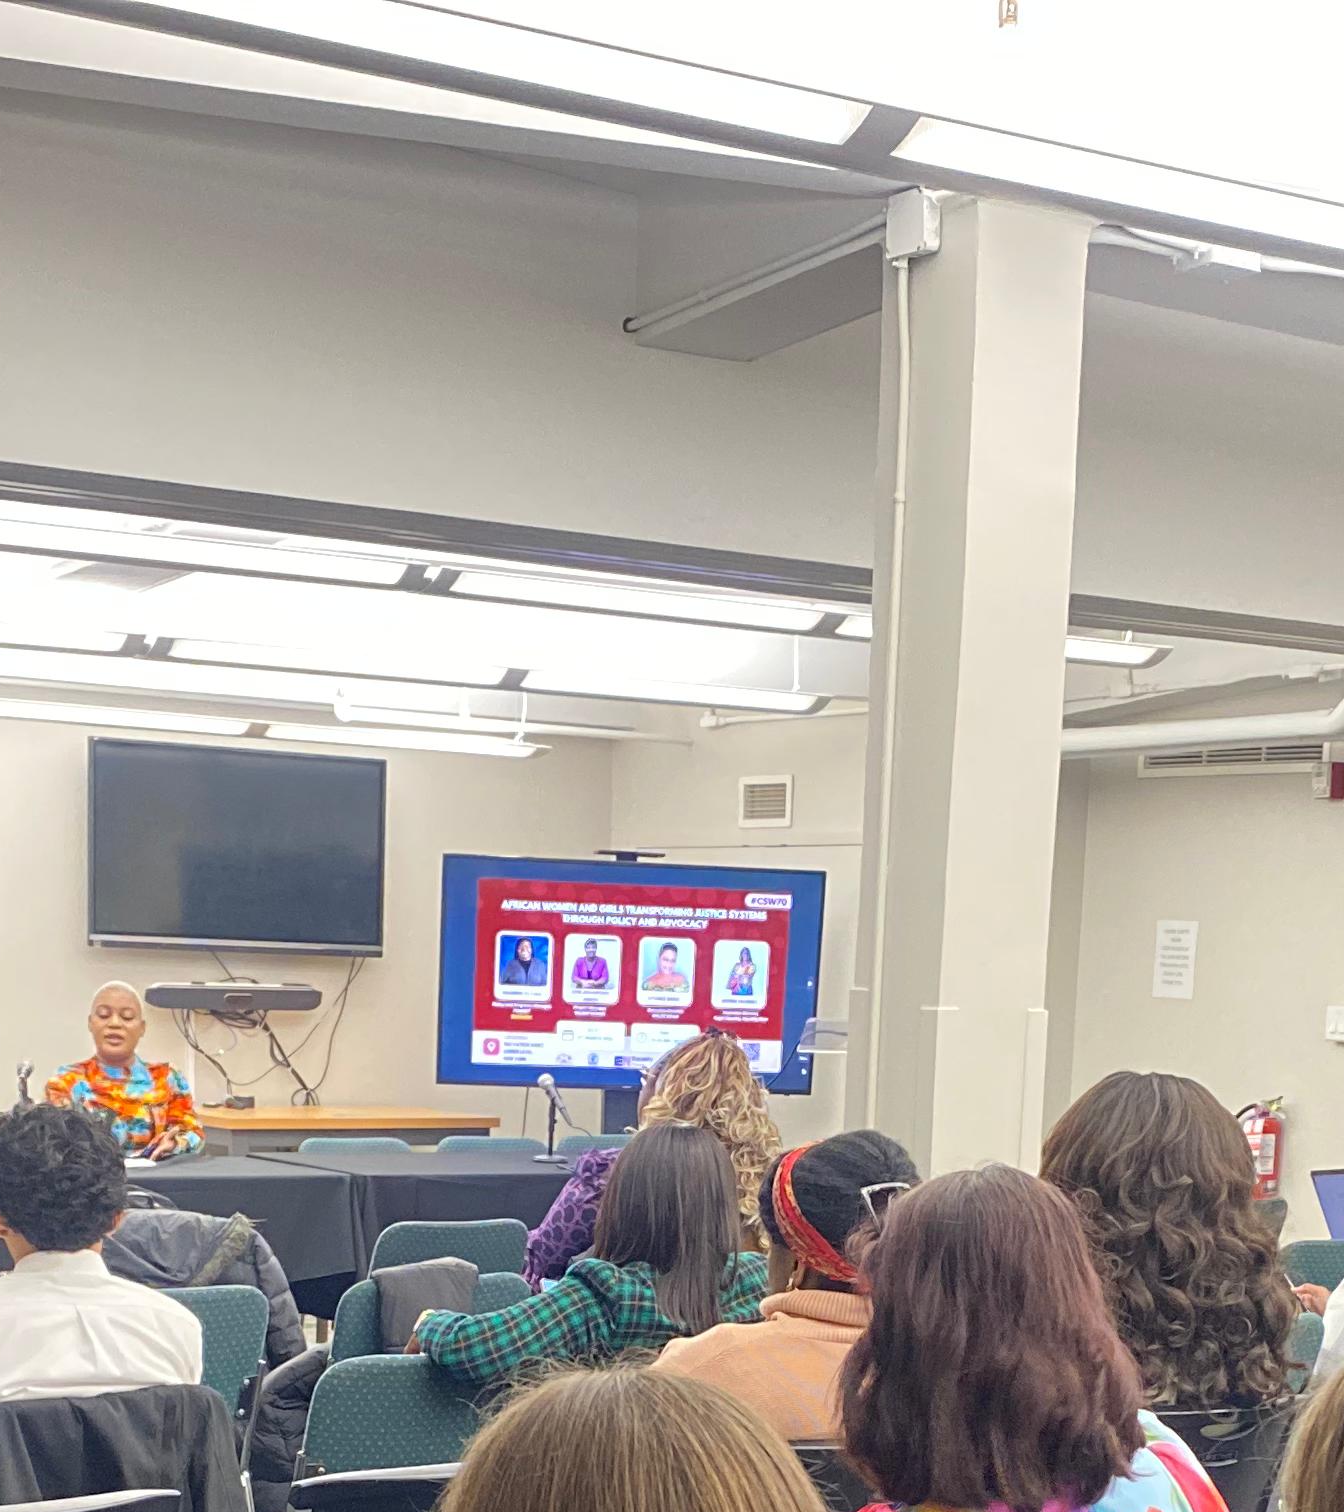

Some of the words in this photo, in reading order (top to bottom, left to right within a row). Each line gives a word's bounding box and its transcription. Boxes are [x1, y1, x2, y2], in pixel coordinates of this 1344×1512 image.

[751, 895, 788, 906] #CSW70
[501, 899, 541, 910] AFRICAN
[542, 901, 577, 912] WOMEN
[578, 903, 597, 913] AND
[694, 908, 728, 919] JUSTICE
[729, 910, 767, 921] SYSTEMS
[562, 914, 604, 924] THROUGH
[606, 915, 637, 926] POLICY
[638, 917, 657, 927] AND
[658, 918, 709, 929] ADVOCACY
